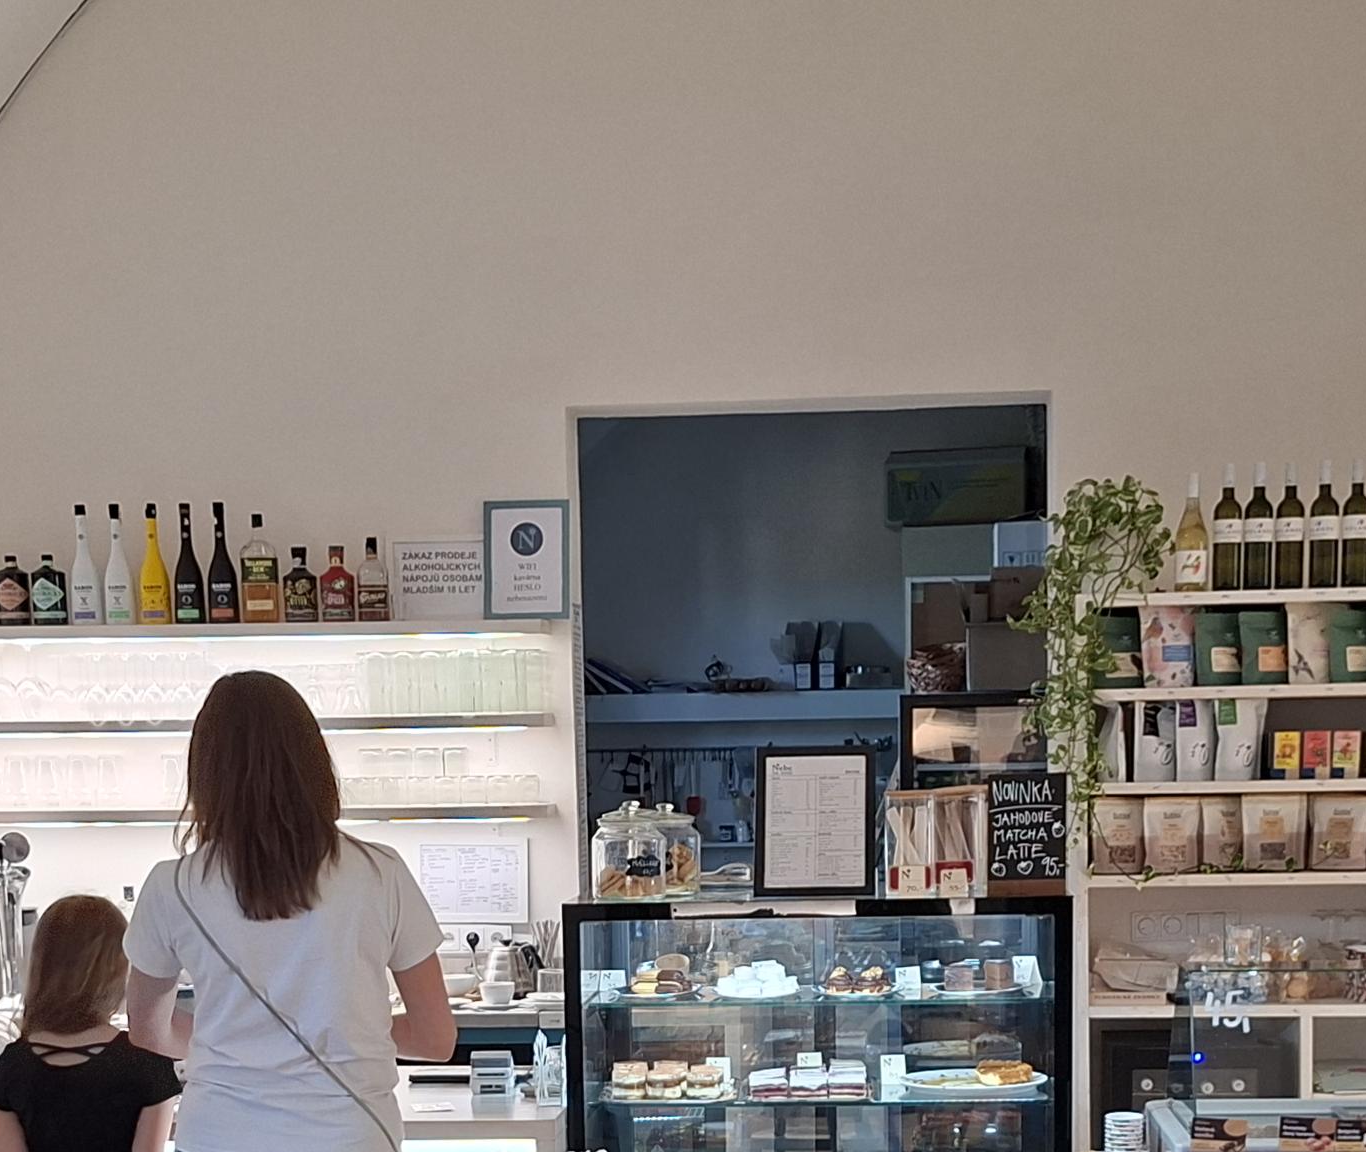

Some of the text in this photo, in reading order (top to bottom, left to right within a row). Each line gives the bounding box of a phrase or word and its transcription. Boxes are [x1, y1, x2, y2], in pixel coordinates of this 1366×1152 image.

[435, 551, 477, 560] PRODEJE
[402, 572, 440, 582] NÁPOJŮ
[446, 585, 457, 593] 18
[459, 585, 476, 593] LET
[992, 779, 1053, 805] NOVINKA
[992, 807, 1058, 827] JAHODOVÉ
[993, 829, 1048, 844] MATCHA
[995, 844, 1046, 860] LATTE
